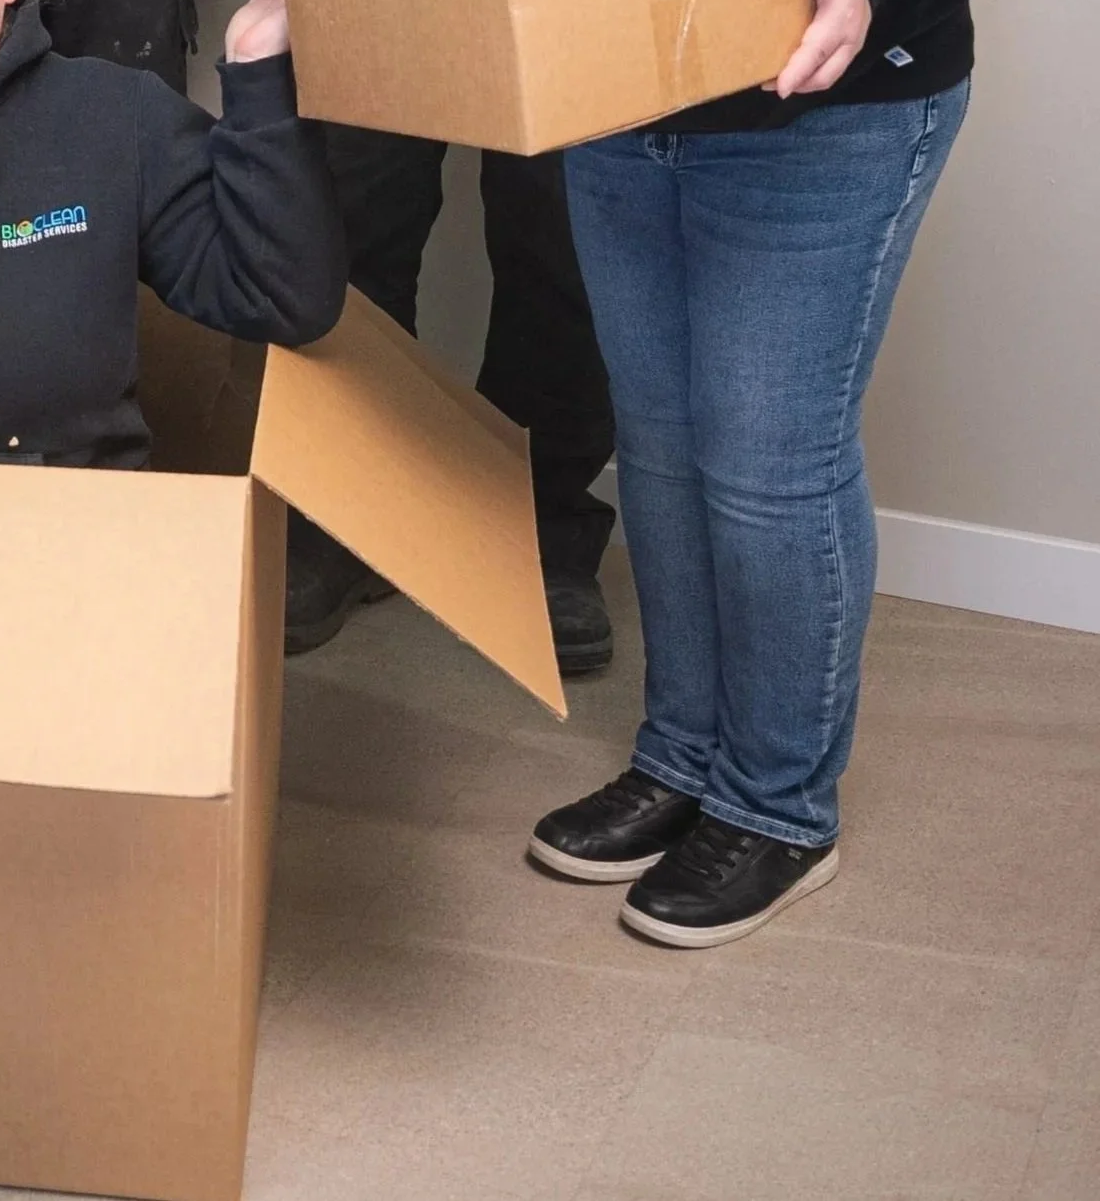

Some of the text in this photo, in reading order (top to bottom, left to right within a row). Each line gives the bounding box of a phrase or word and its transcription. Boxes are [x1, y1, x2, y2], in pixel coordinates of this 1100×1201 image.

[1, 205, 87, 239] BIOCLEAN
[2, 221, 88, 248] DISASTER SERVICES
